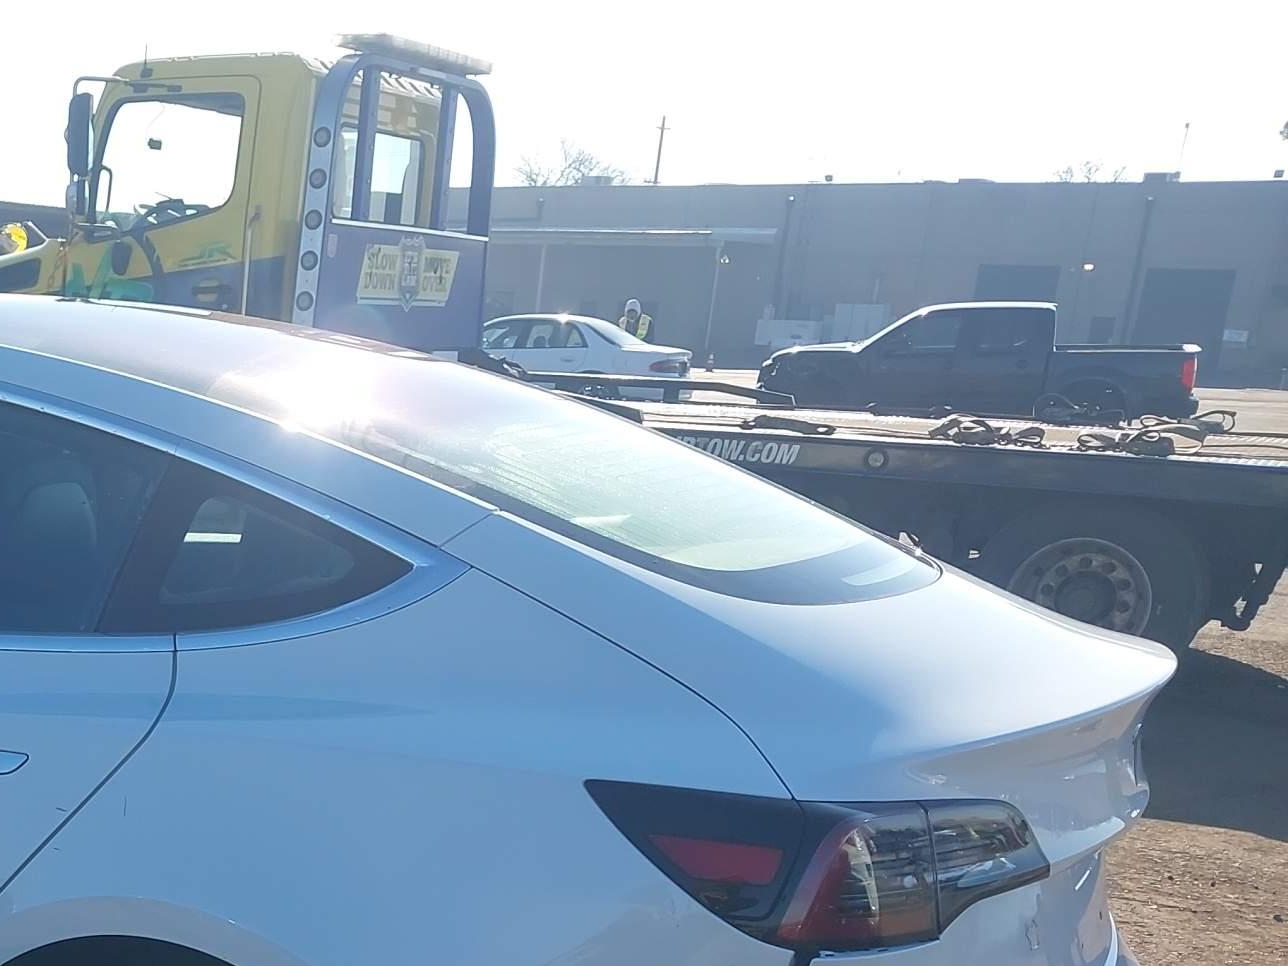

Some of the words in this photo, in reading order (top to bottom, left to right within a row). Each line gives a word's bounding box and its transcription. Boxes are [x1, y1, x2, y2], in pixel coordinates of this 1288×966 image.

[368, 247, 399, 271] SLOW
[424, 256, 452, 274] MOVE
[364, 272, 398, 291] DOWN
[422, 274, 448, 292] OVER
